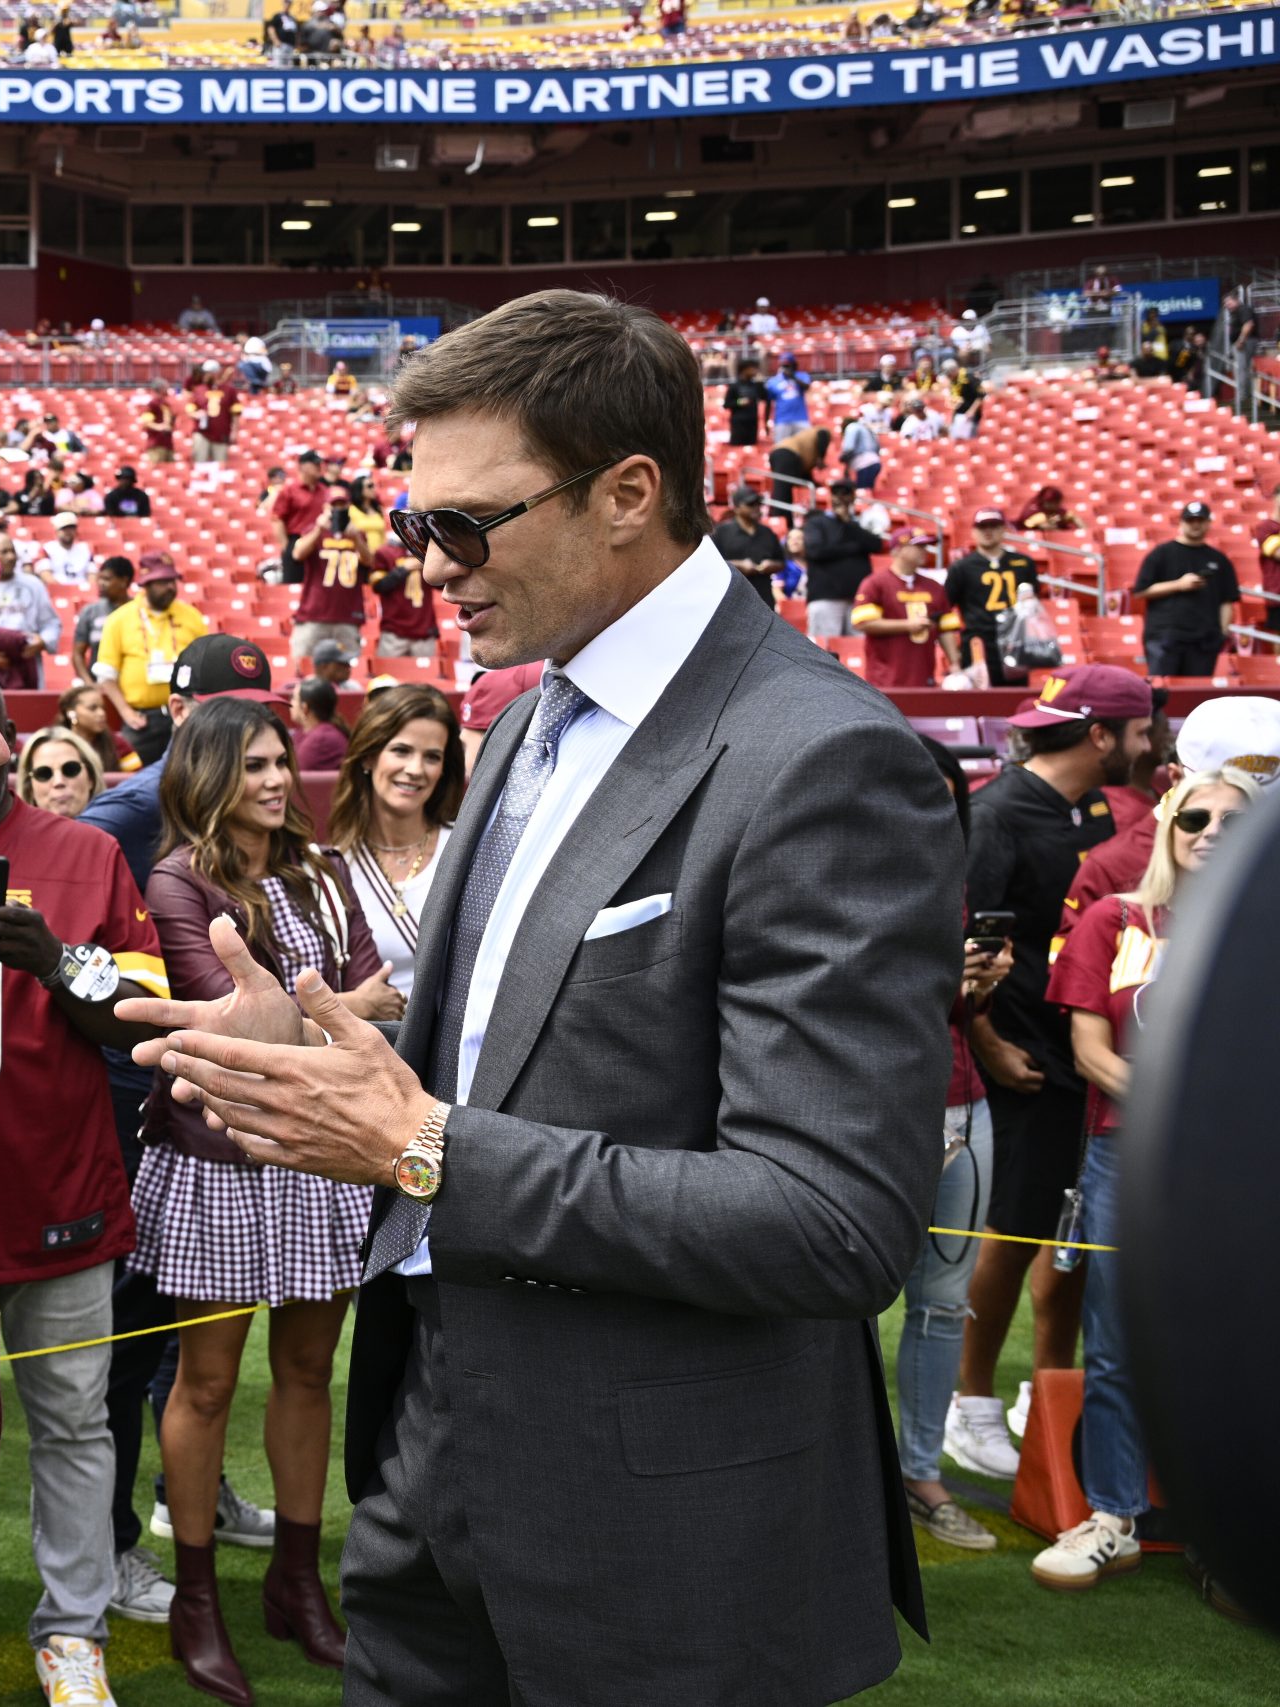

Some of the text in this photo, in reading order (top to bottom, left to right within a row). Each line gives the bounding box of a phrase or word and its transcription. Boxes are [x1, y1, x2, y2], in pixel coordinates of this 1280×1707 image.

[200, 77, 477, 114] MEDICINE
[494, 69, 771, 114] PARTNER
[788, 61, 874, 100] OF
[890, 49, 1020, 94] THE
[1040, 17, 1275, 79] WASHI
[319, 549, 359, 588] 70
[981, 571, 1017, 611] 21
[75, 946, 91, 962] C
